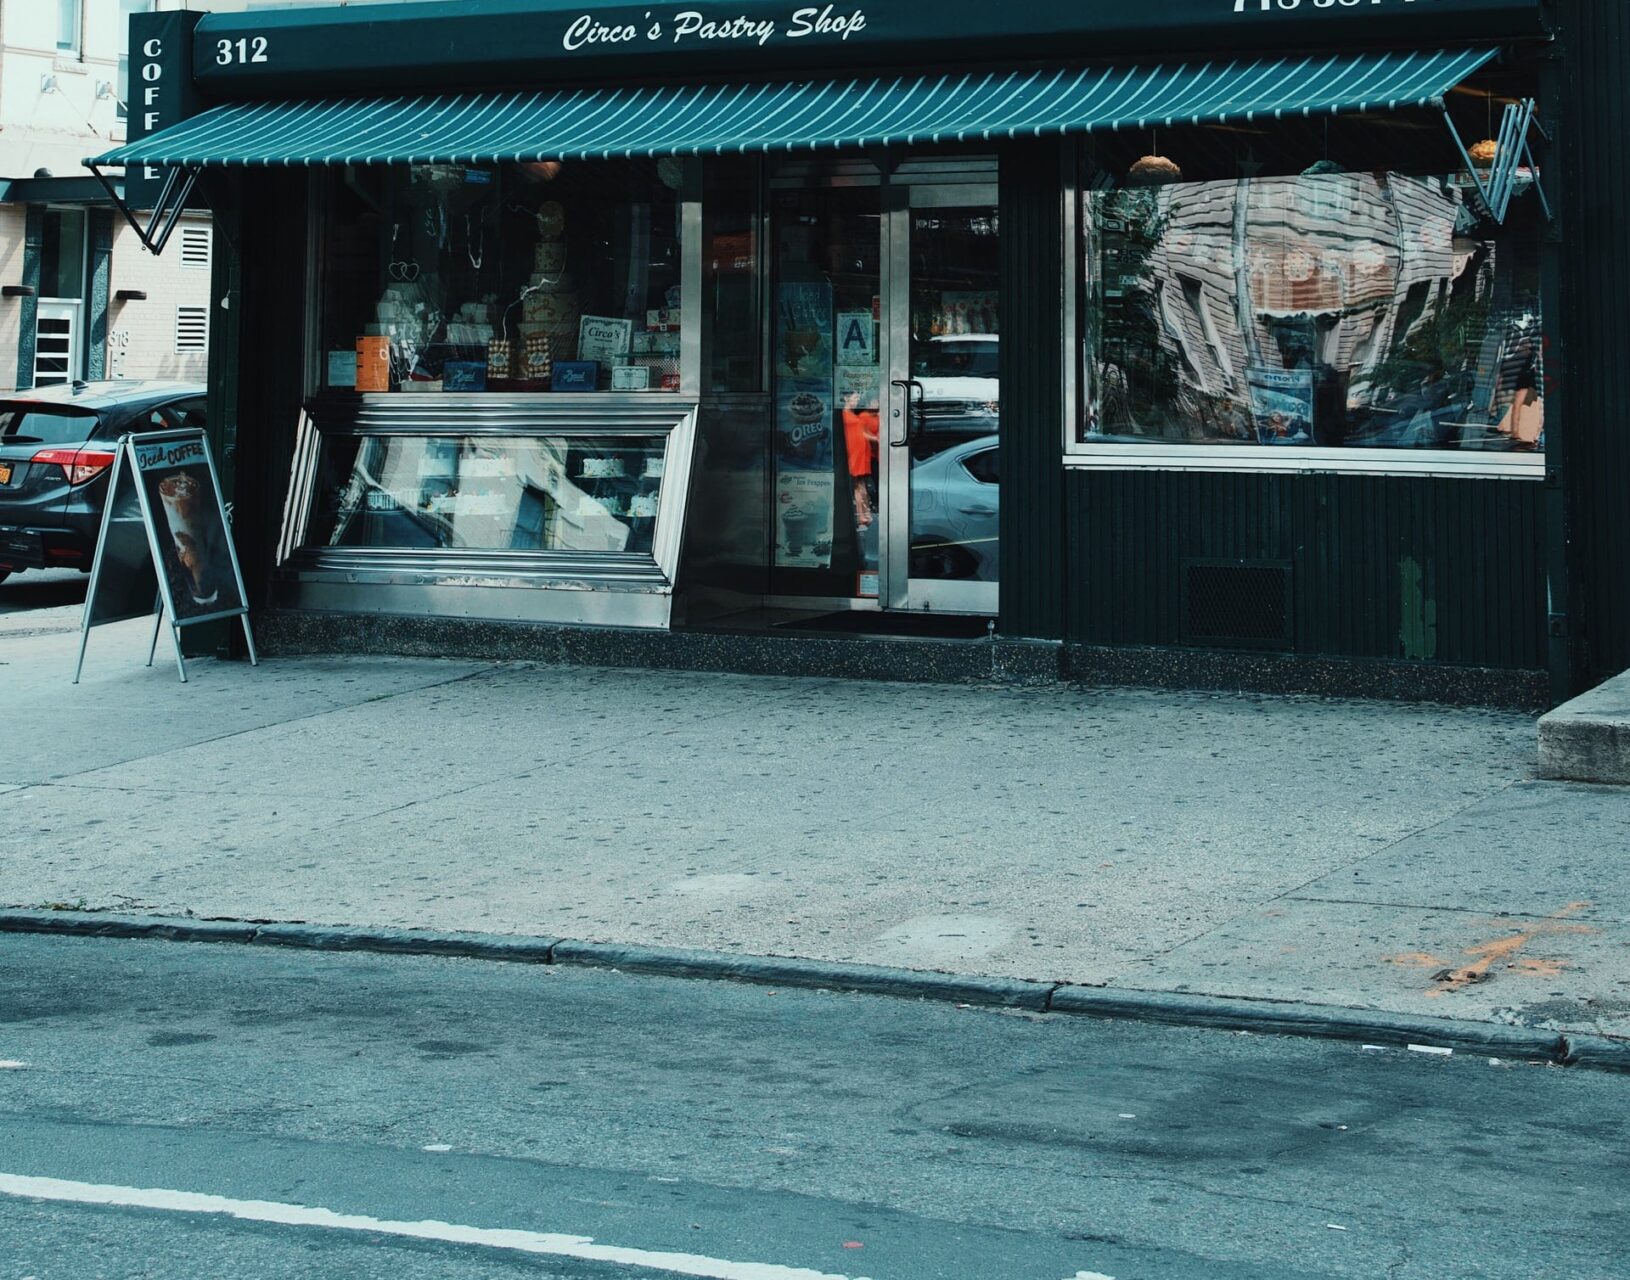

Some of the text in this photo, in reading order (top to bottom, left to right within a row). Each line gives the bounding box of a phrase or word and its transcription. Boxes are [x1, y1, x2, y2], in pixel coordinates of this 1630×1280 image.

[215, 3, 867, 66] 312 Circo's Pastry Shop
[141, 38, 163, 180] COFFE
[587, 326, 622, 340] Circo's
[842, 318, 868, 350] A
[791, 422, 823, 442] OREO
[139, 442, 204, 469] Iced COFFEE
